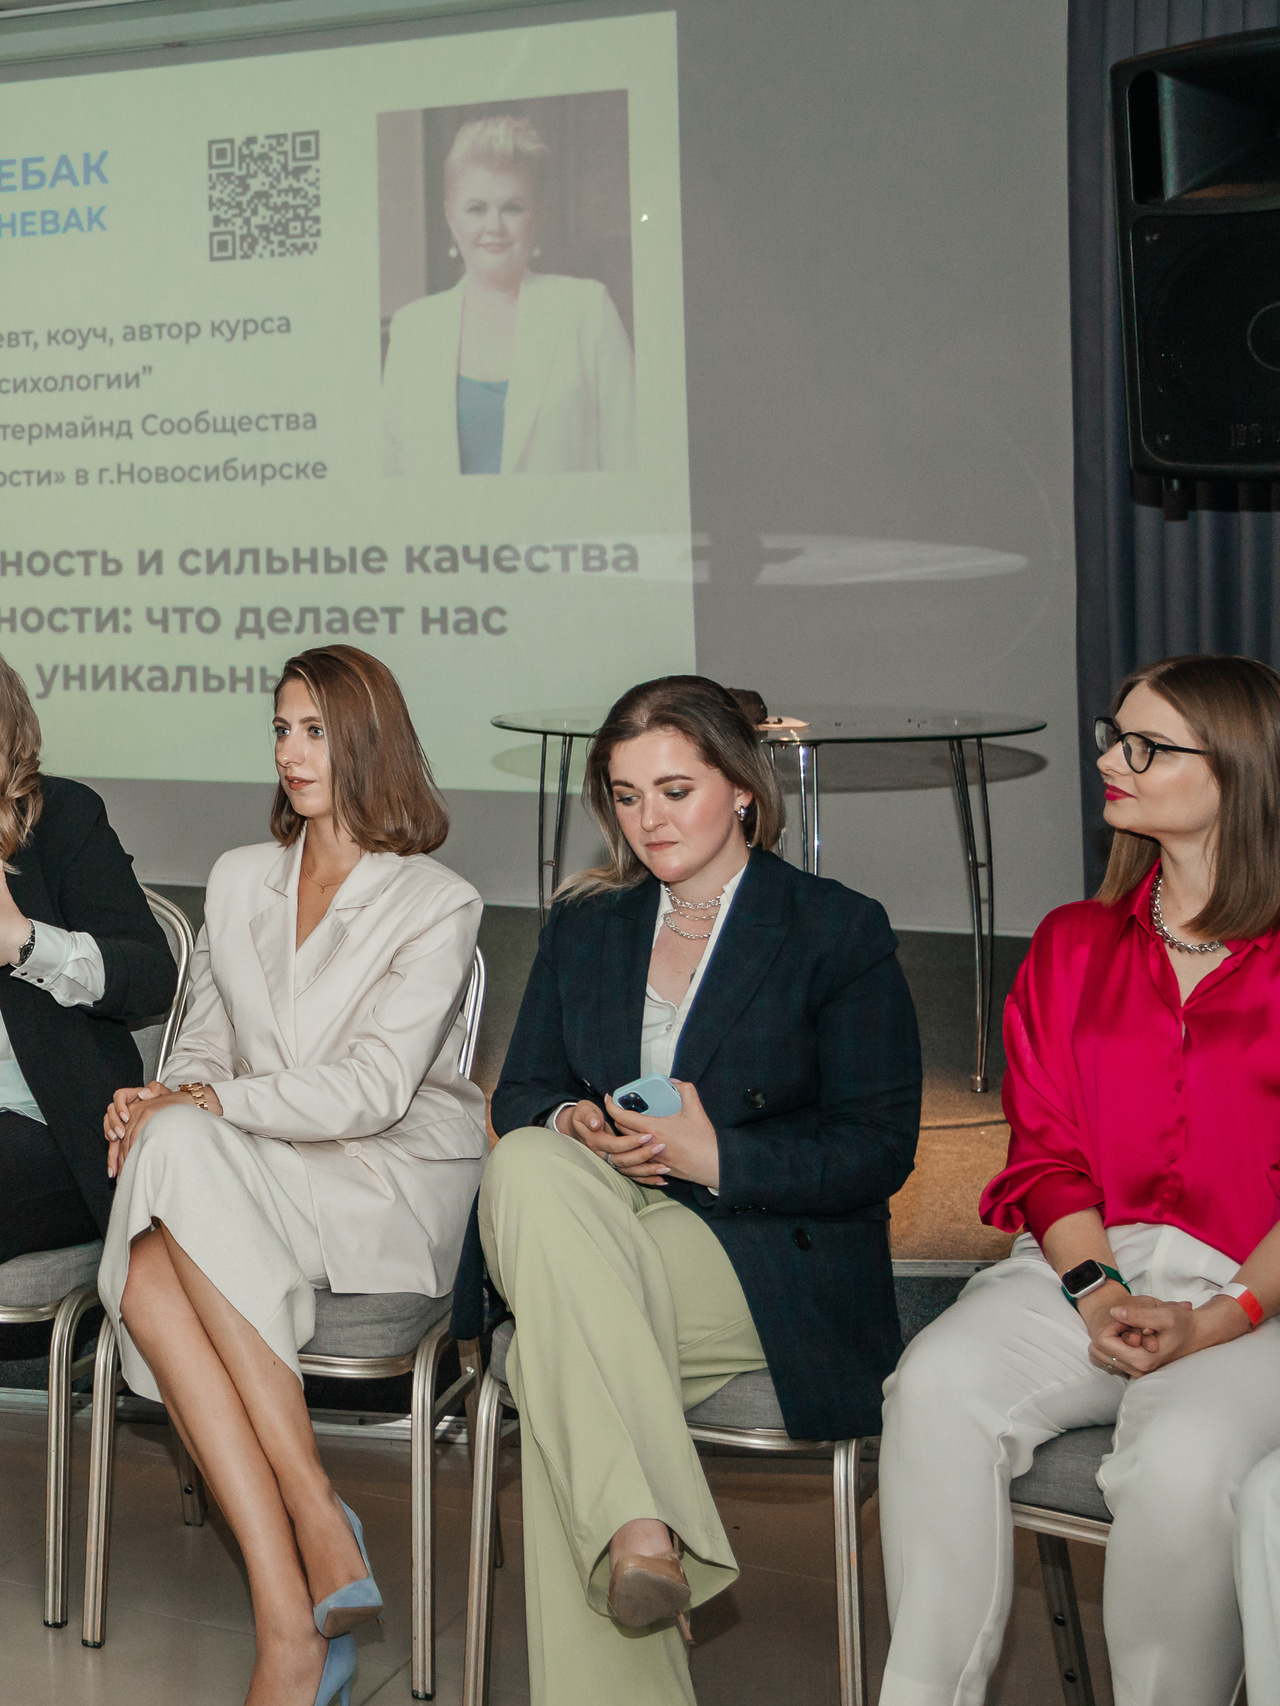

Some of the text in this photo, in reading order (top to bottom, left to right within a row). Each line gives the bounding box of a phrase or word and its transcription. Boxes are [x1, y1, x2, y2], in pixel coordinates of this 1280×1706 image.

[46, 326, 115, 351] коуч,
[123, 321, 201, 343] автор
[211, 316, 291, 342] курса
[141, 410, 317, 435] Сообщества
[75, 471, 90, 487] в
[99, 457, 327, 485] г.Новосибирске
[138, 549, 163, 575] и
[179, 545, 388, 576] сильные
[405, 543, 640, 574] качества
[146, 606, 221, 634] что
[235, 606, 405, 639] делает
[421, 606, 507, 635] нас
